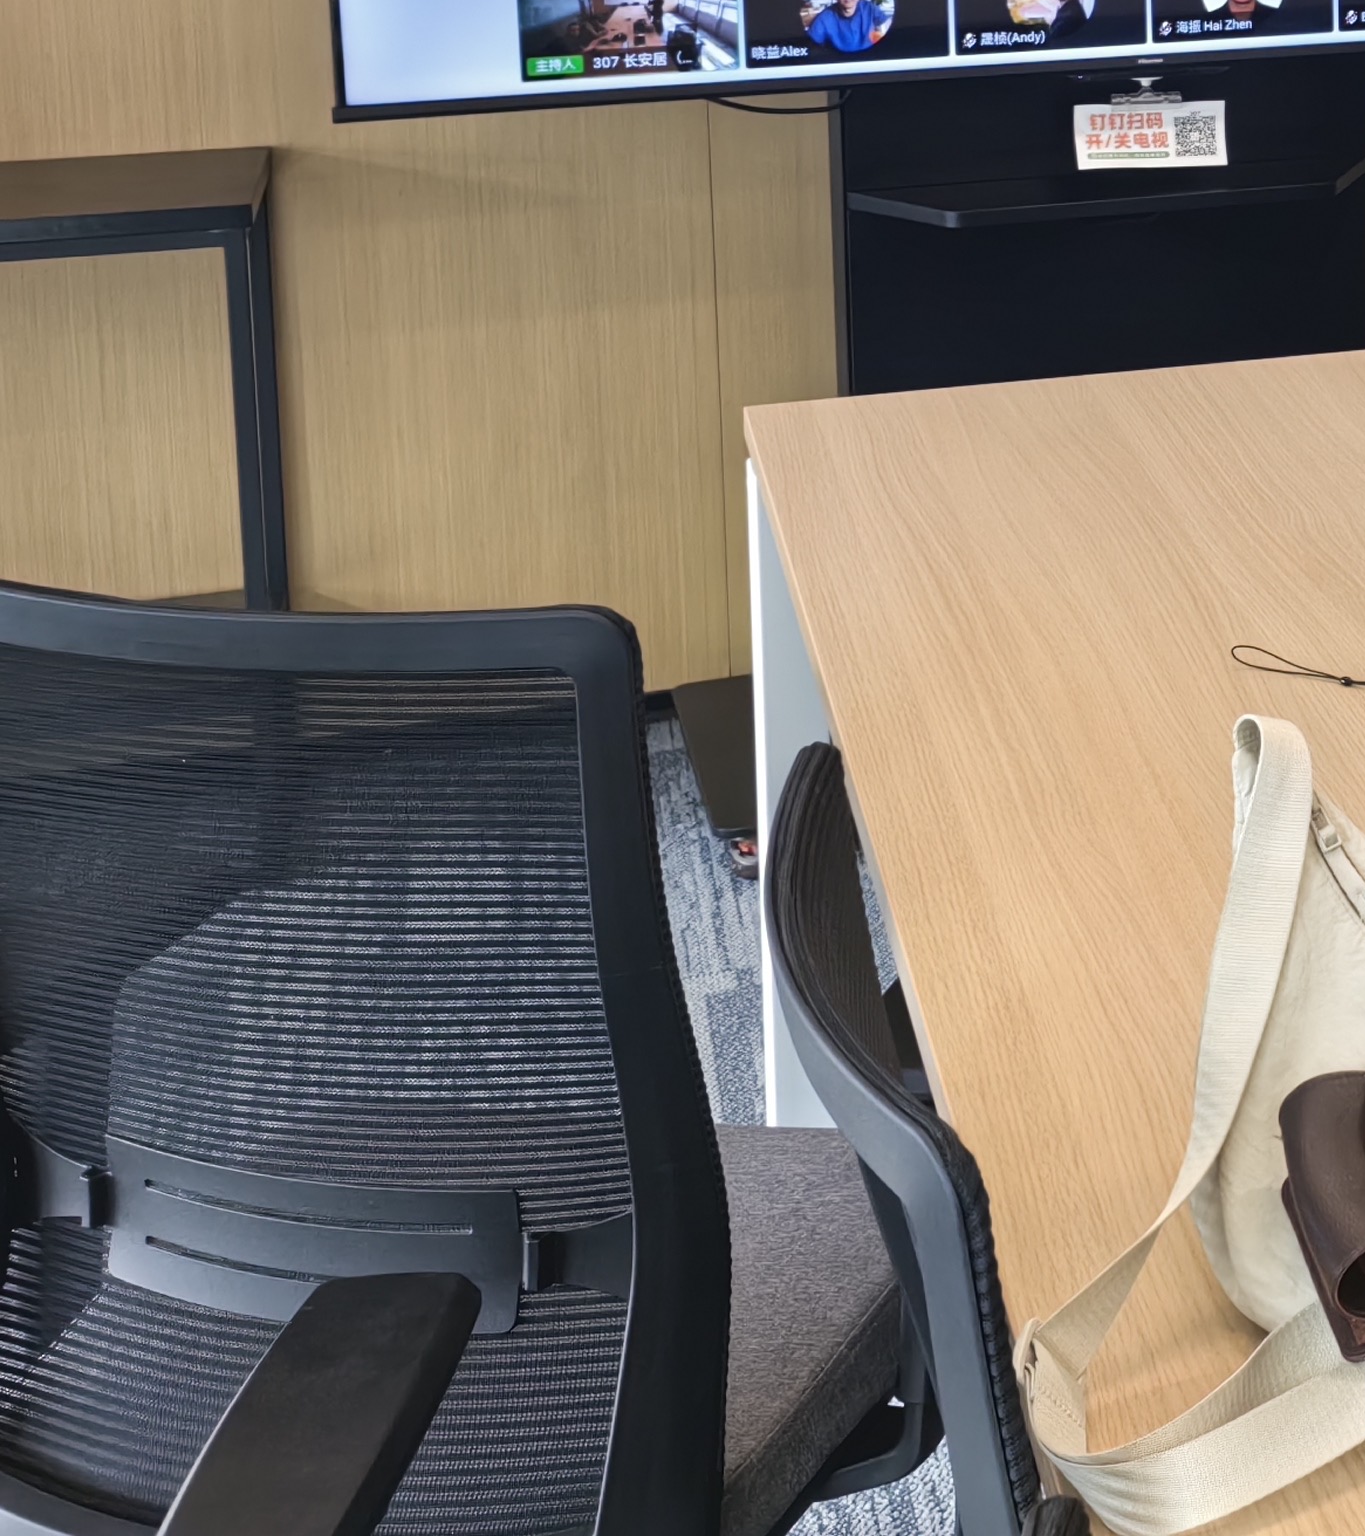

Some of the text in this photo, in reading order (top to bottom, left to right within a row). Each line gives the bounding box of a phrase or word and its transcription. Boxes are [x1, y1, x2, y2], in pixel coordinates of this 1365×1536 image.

[1204, 19, 1222, 32] Hai
[1225, 18, 1253, 31] Zhen
[535, 57, 577, 73] 主持人
[593, 56, 620, 70] 307
[623, 51, 668, 68] 长安居
[1089, 112, 1164, 131] 钉钉扫码
[1085, 131, 1170, 149] 开/关电视
